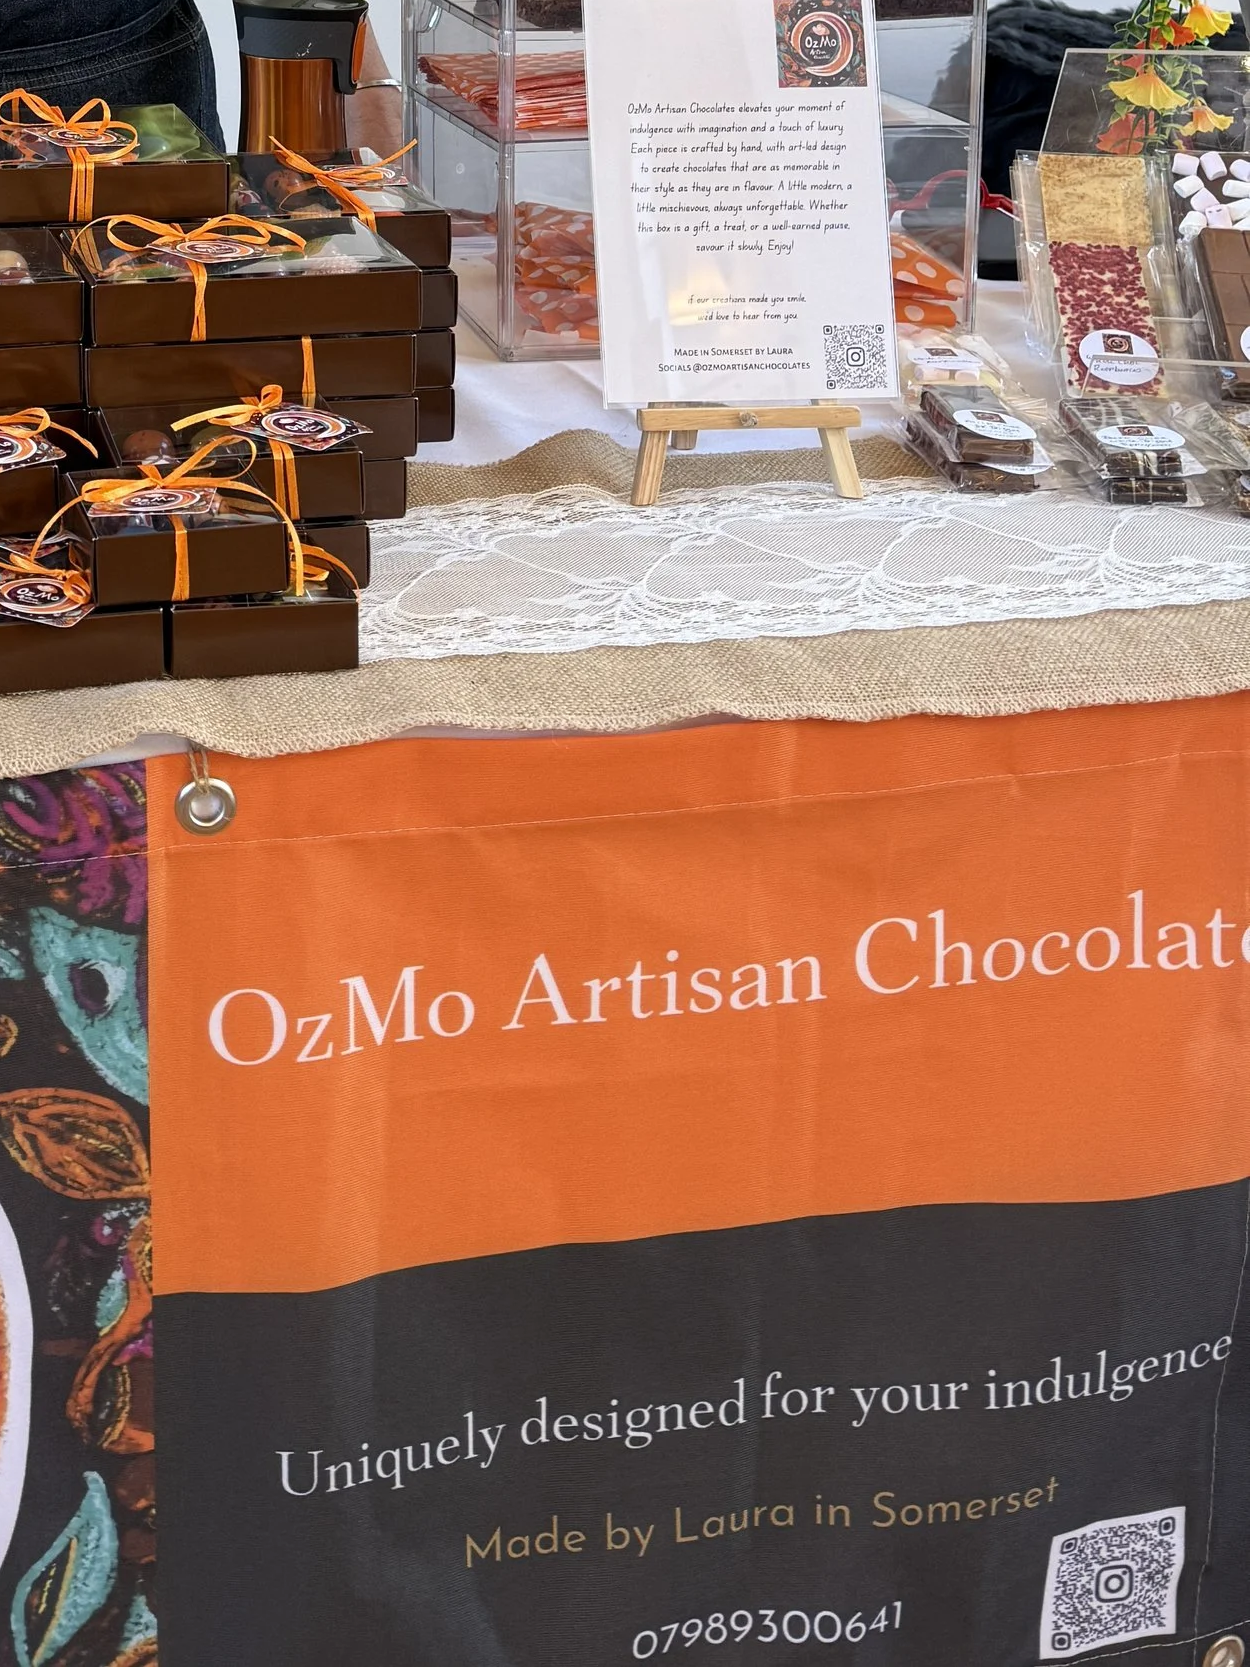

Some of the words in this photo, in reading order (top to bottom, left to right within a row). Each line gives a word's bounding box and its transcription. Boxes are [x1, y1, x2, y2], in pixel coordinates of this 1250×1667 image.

[805, 36, 837, 49] OzMo
[628, 103, 652, 114] OzMo
[655, 103, 686, 113] Artisan
[690, 102, 735, 113] Chocolates
[739, 102, 771, 112] elevates
[775, 106, 794, 116] your
[798, 101, 832, 112] moment
[836, 100, 846, 111] of
[209, 966, 474, 1065] OzMo
[502, 950, 826, 1030] Artisan
[276, 1411, 506, 1495] Uniquely
[521, 1378, 746, 1448] designed
[760, 1372, 834, 1418] for
[850, 1383, 968, 1427] your
[985, 1336, 1232, 1409] indulgence
[466, 1515, 586, 1568] Made
[607, 1513, 654, 1557] by
[676, 1505, 794, 1542] Laura
[816, 1495, 850, 1526] in
[872, 1476, 1059, 1527] Somerset
[633, 1601, 901, 1658] 07989300641
